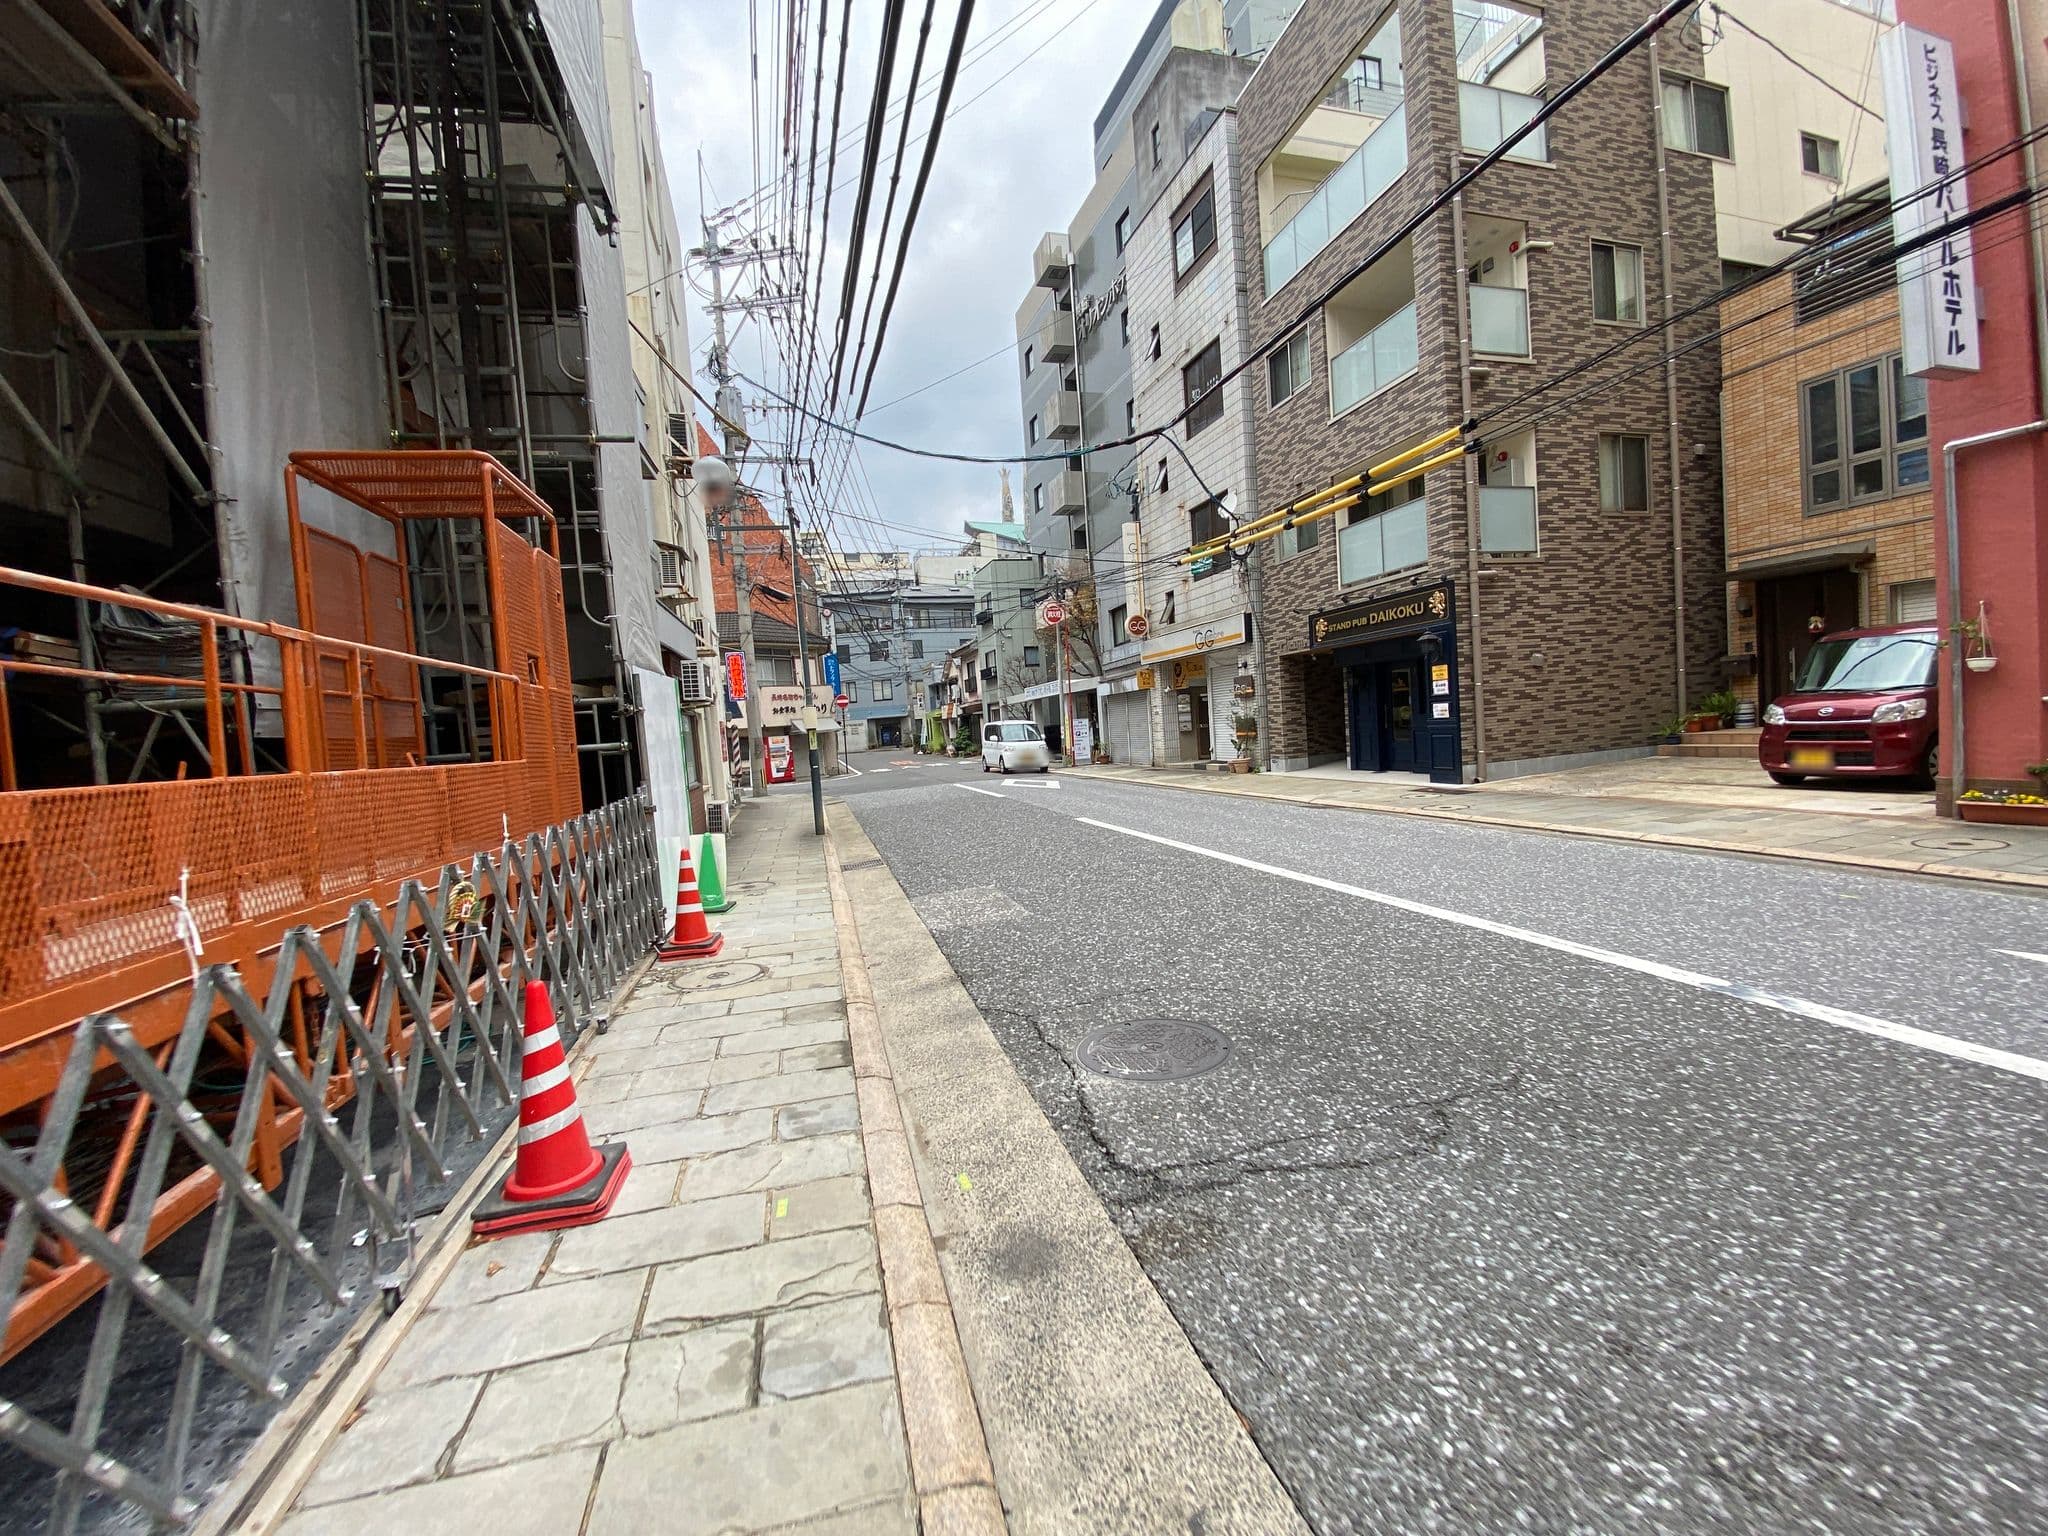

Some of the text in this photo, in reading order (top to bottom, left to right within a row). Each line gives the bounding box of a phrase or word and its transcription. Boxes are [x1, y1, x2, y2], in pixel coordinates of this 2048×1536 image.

[1129, 621, 1146, 631] GG
[1328, 601, 1424, 633] STAND PUB DAIKOKU
[1195, 629, 1214, 650] GG
